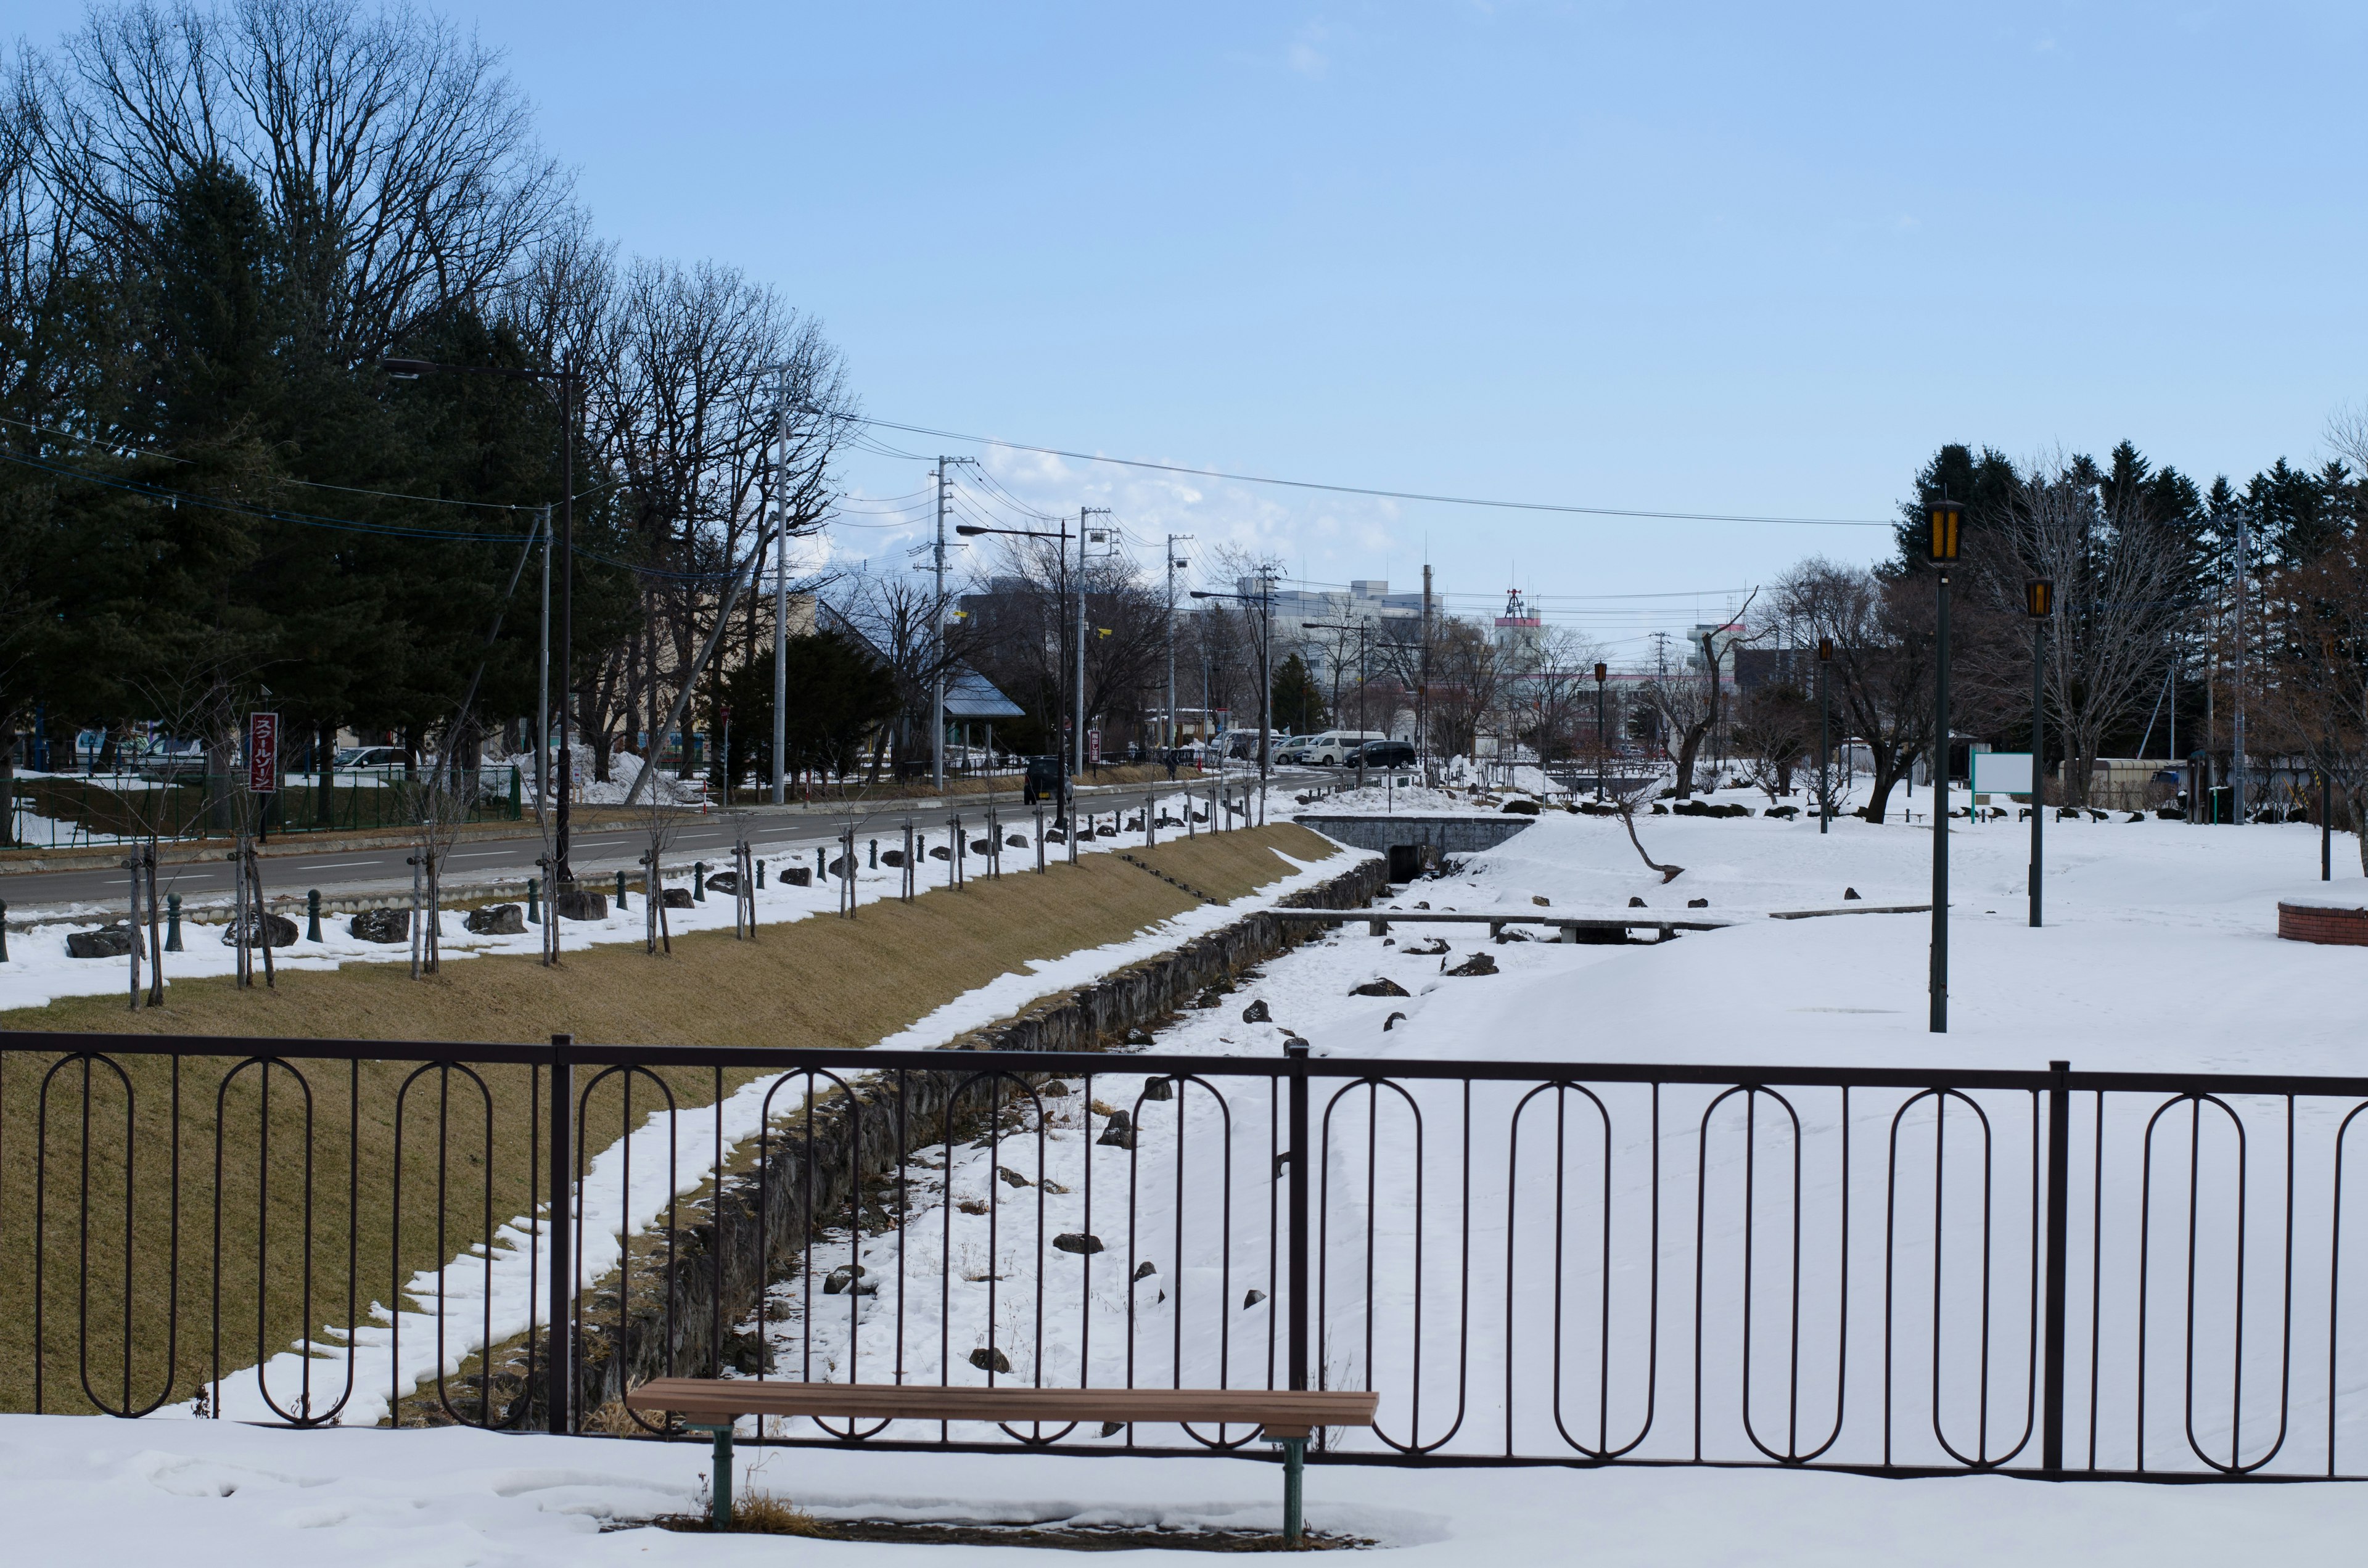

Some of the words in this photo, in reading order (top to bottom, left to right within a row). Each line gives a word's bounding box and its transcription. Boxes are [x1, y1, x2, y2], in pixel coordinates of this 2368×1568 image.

[255, 720, 271, 787] スクールゾーン
